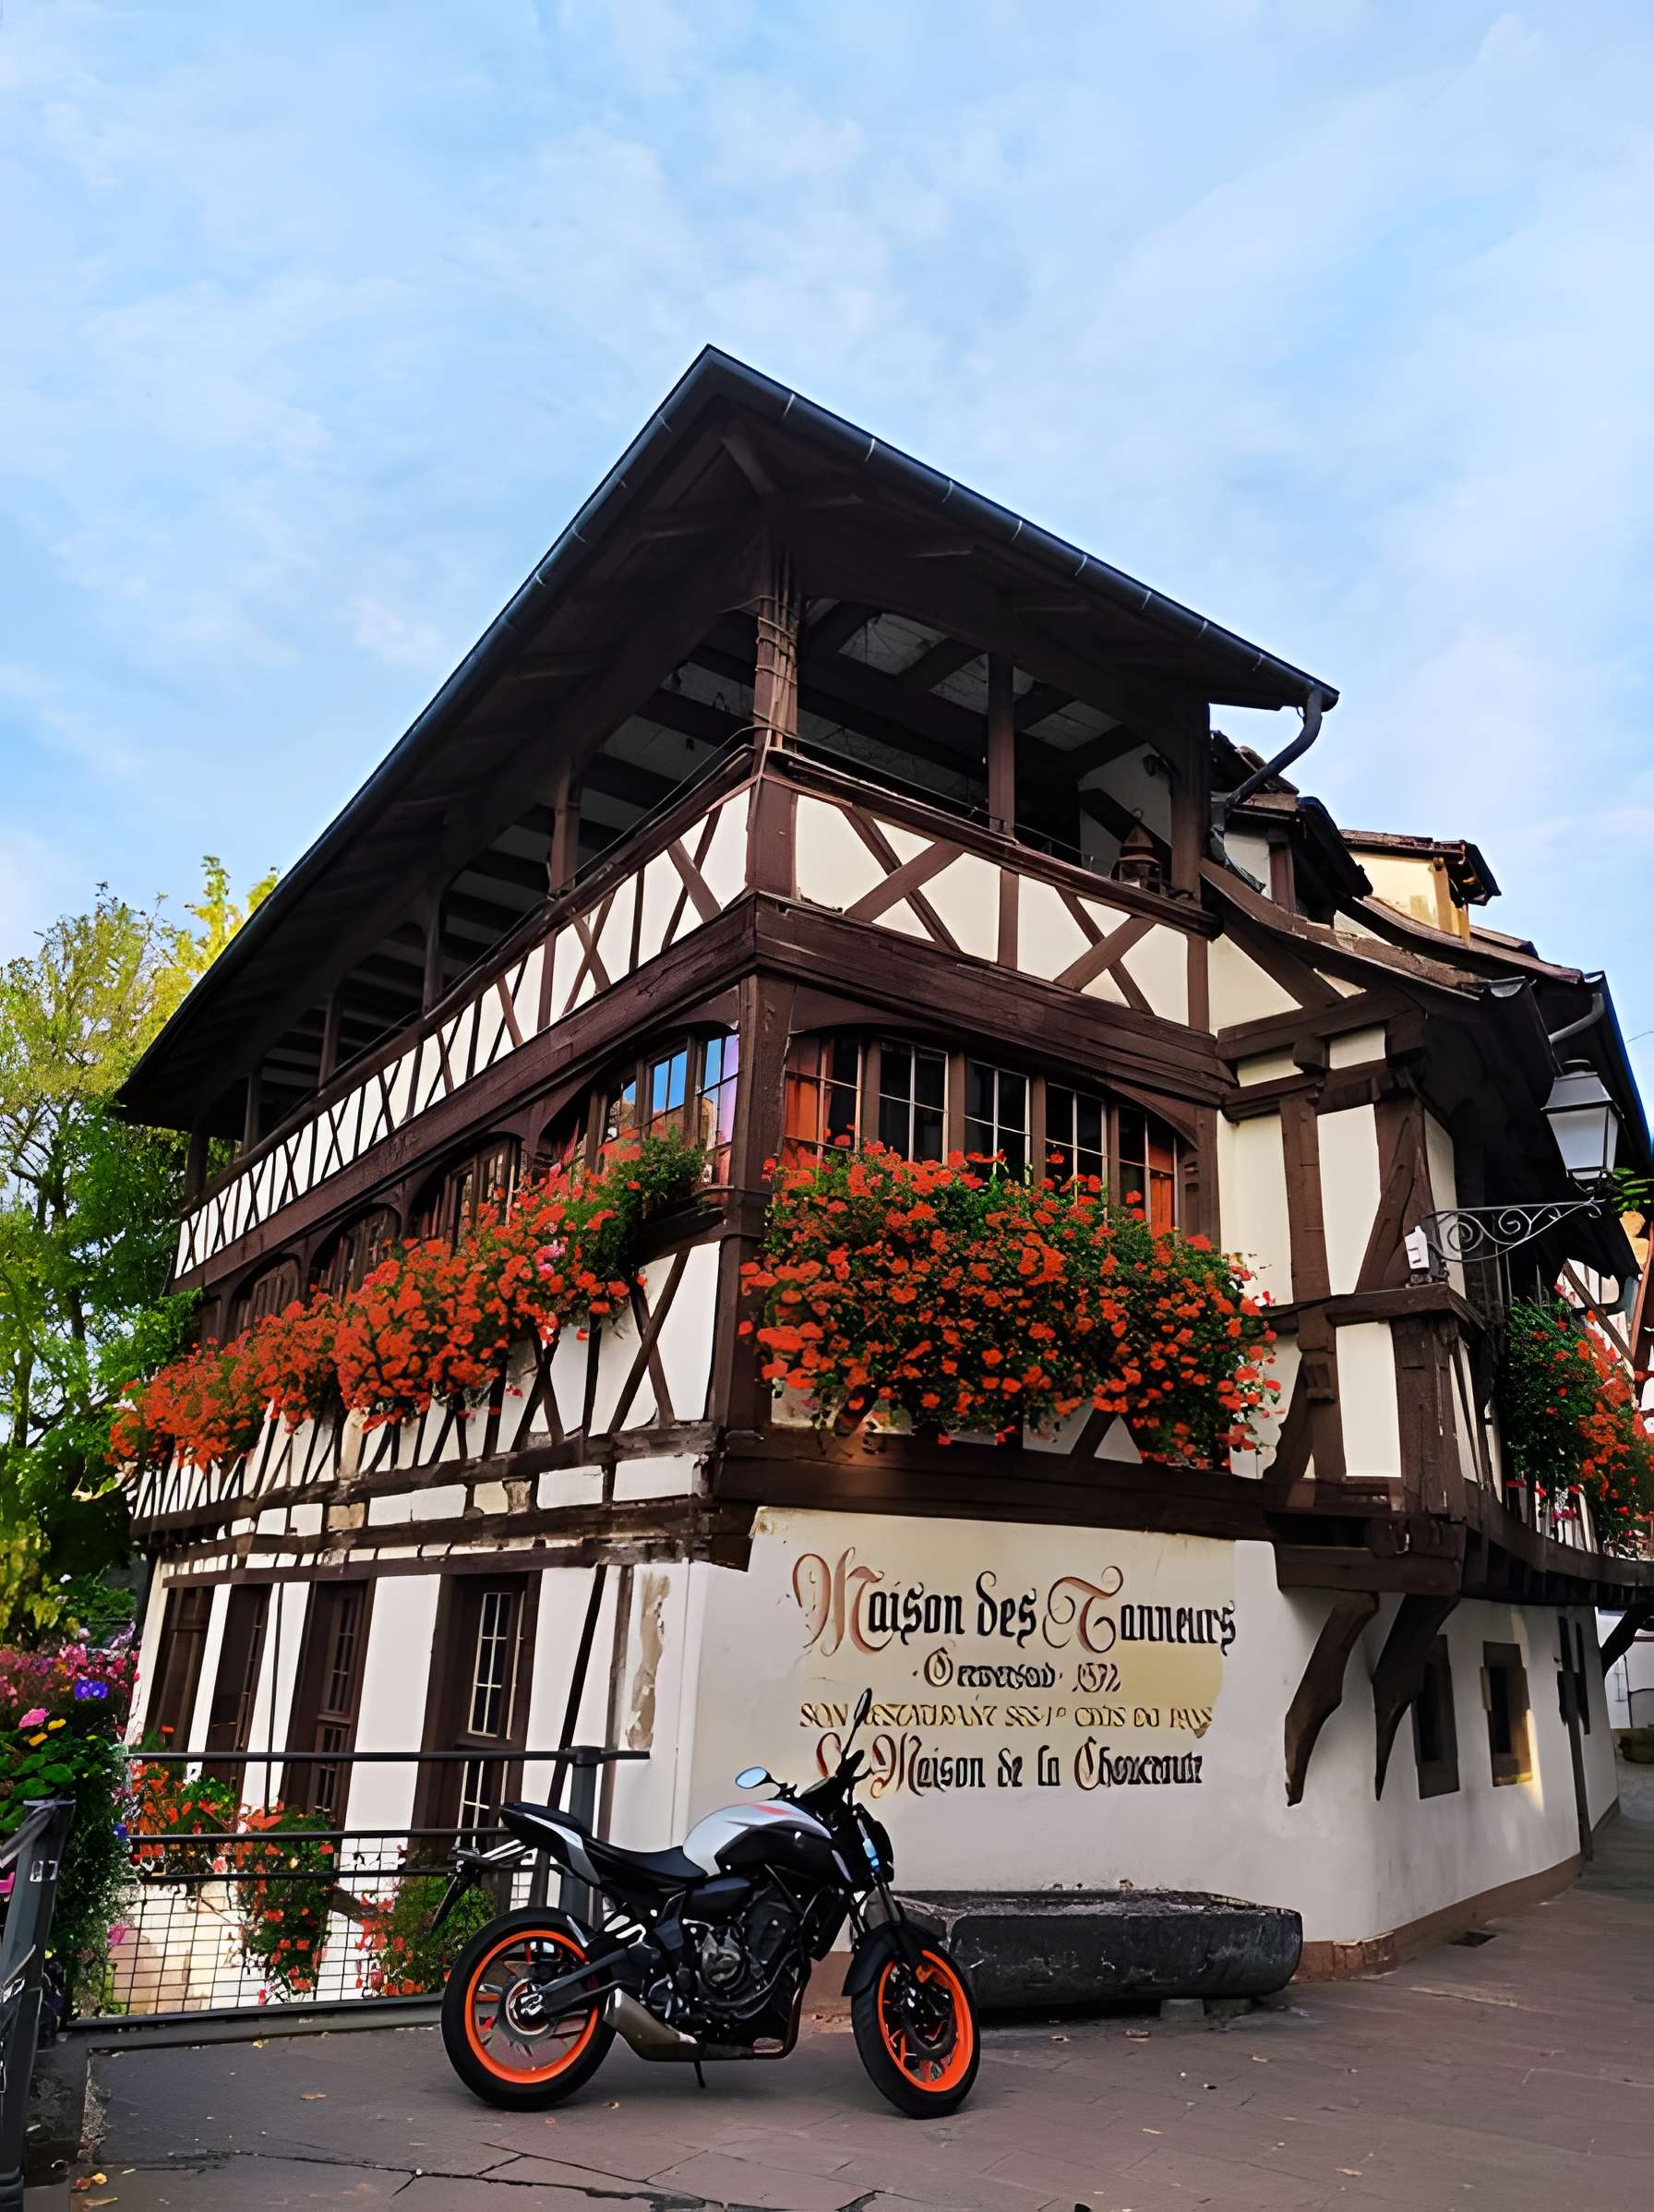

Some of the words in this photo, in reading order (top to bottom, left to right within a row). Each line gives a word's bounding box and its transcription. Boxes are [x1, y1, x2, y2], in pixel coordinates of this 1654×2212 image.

[792, 1546, 965, 1656] Maison
[977, 1570, 1037, 1648] des
[1042, 1565, 1236, 1656] Tanneurs
[870, 1732, 986, 1798] Maison
[997, 1748, 1023, 1787] de
